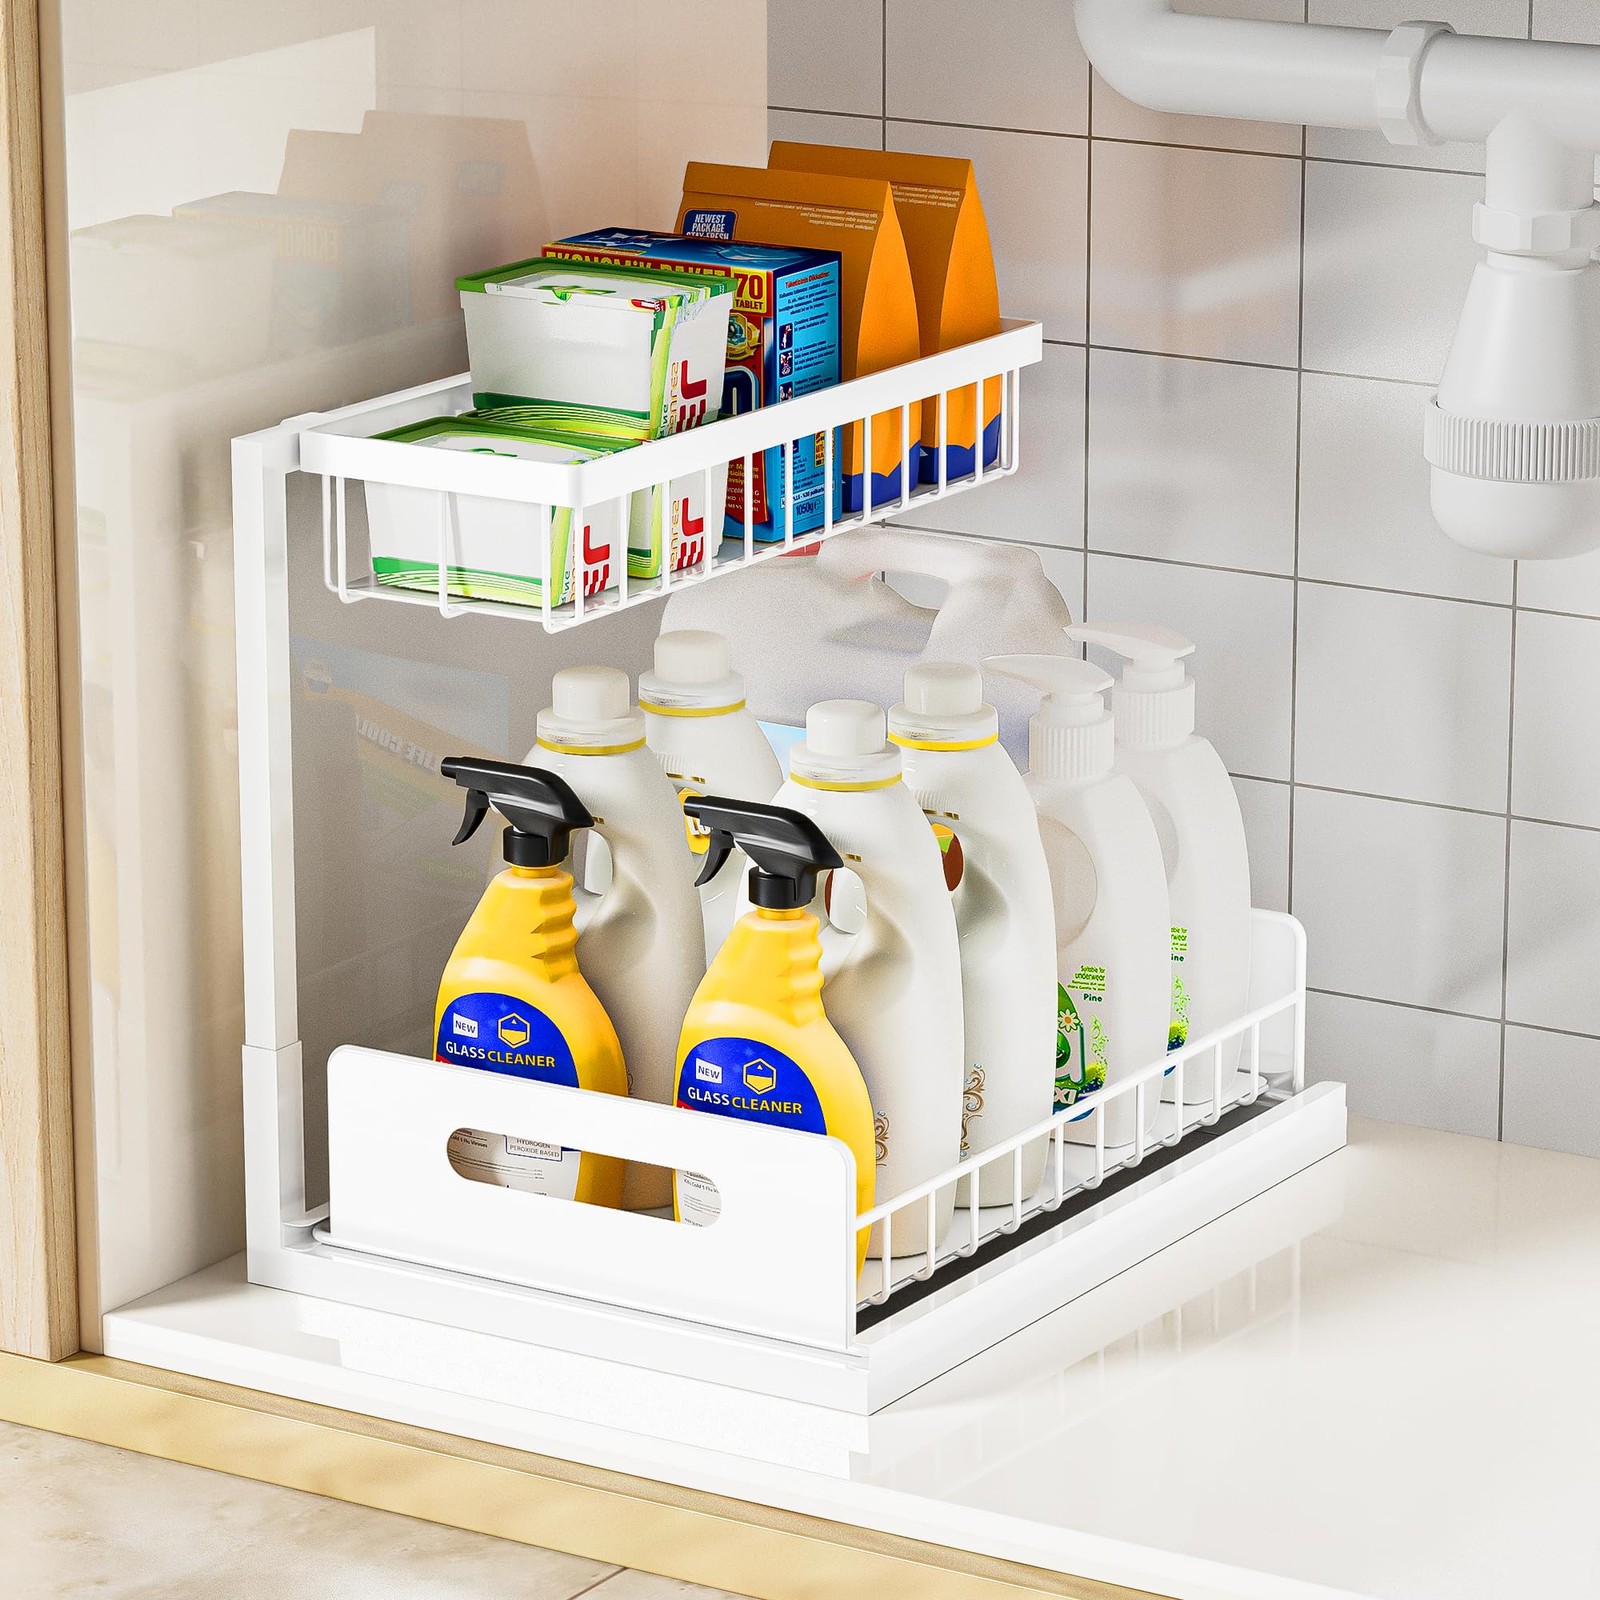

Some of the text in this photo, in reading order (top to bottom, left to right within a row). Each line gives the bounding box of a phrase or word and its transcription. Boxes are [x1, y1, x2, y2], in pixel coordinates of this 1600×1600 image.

[694, 213, 726, 224] NEWEST
[691, 222, 726, 233] PACKAGE
[734, 272, 763, 300] 70
[735, 299, 764, 311] TABLET
[1171, 953, 1185, 962] ine
[1083, 993, 1103, 1003] Pine
[455, 1020, 476, 1034] NEW
[445, 1040, 556, 1068] GLASS CLEANER
[698, 1065, 720, 1080] NEW
[687, 1086, 803, 1114] GLASS CLEANER
[516, 1138, 551, 1149] HYDROGEN
[509, 1145, 560, 1158] PEROXIDE BASED
